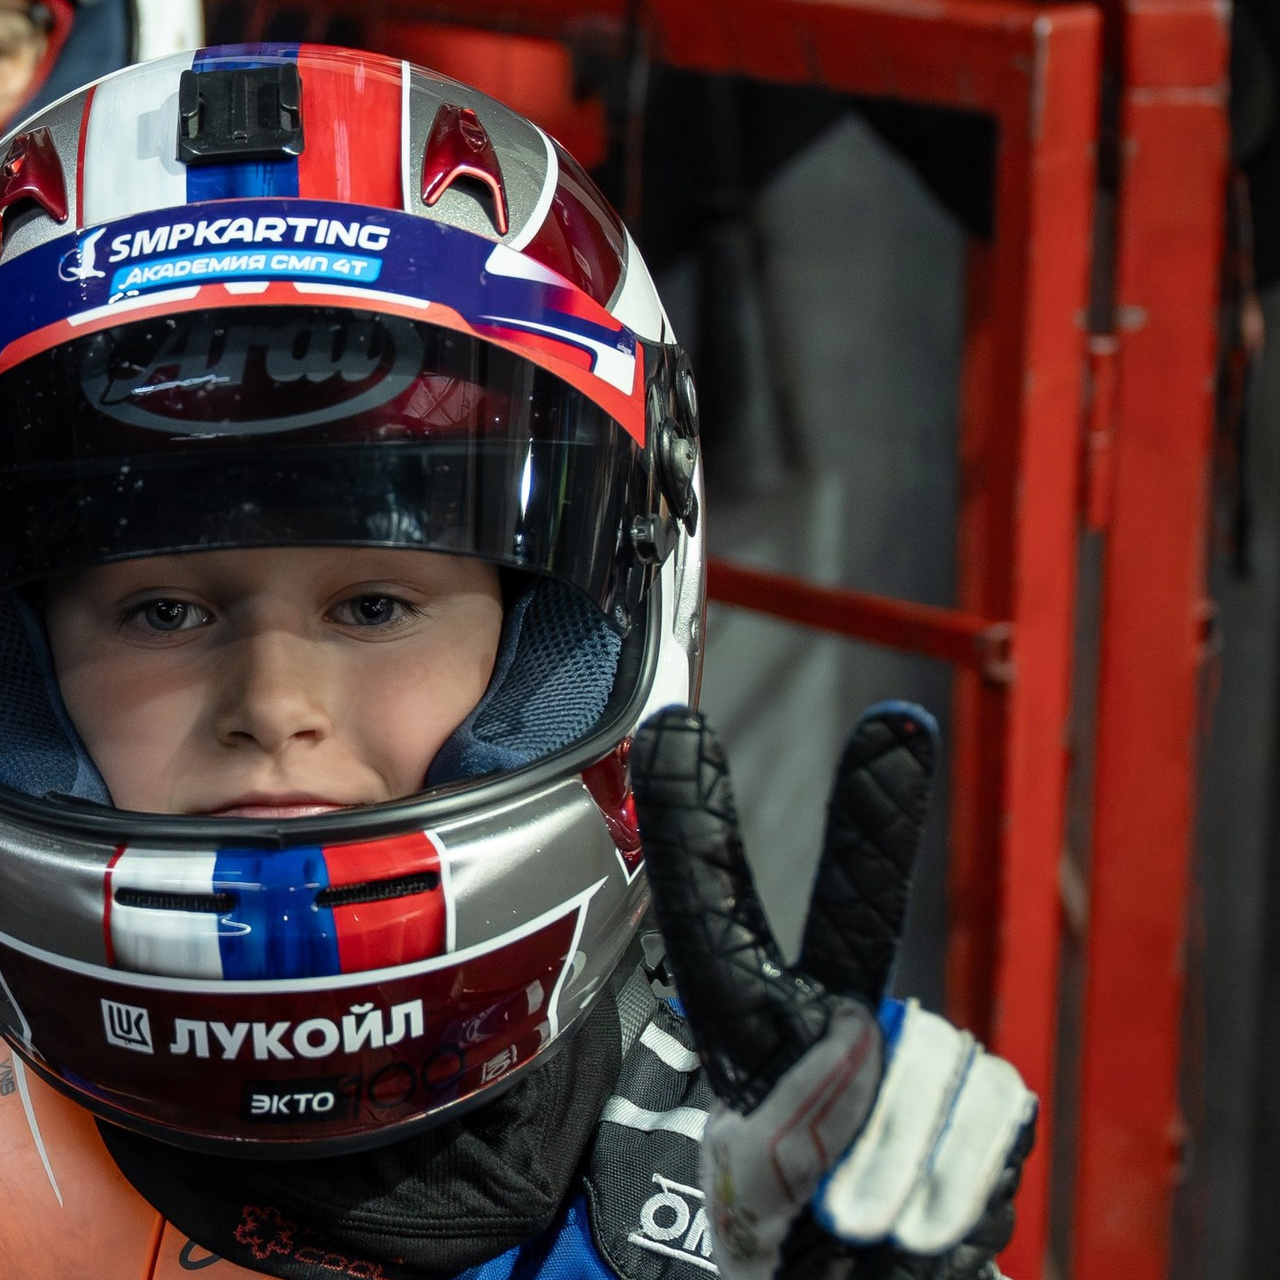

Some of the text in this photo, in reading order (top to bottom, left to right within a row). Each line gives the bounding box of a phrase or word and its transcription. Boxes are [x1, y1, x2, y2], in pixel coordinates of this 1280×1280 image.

[108, 217, 392, 263] SMPKARTING
[122, 254, 266, 287] АКАДЕМИЯ
[270, 254, 329, 273] СМП
[169, 999, 425, 1061] ЛУКОЙЛ
[250, 1090, 336, 1115] ЭКТО
[640, 1192, 713, 1258] OM
